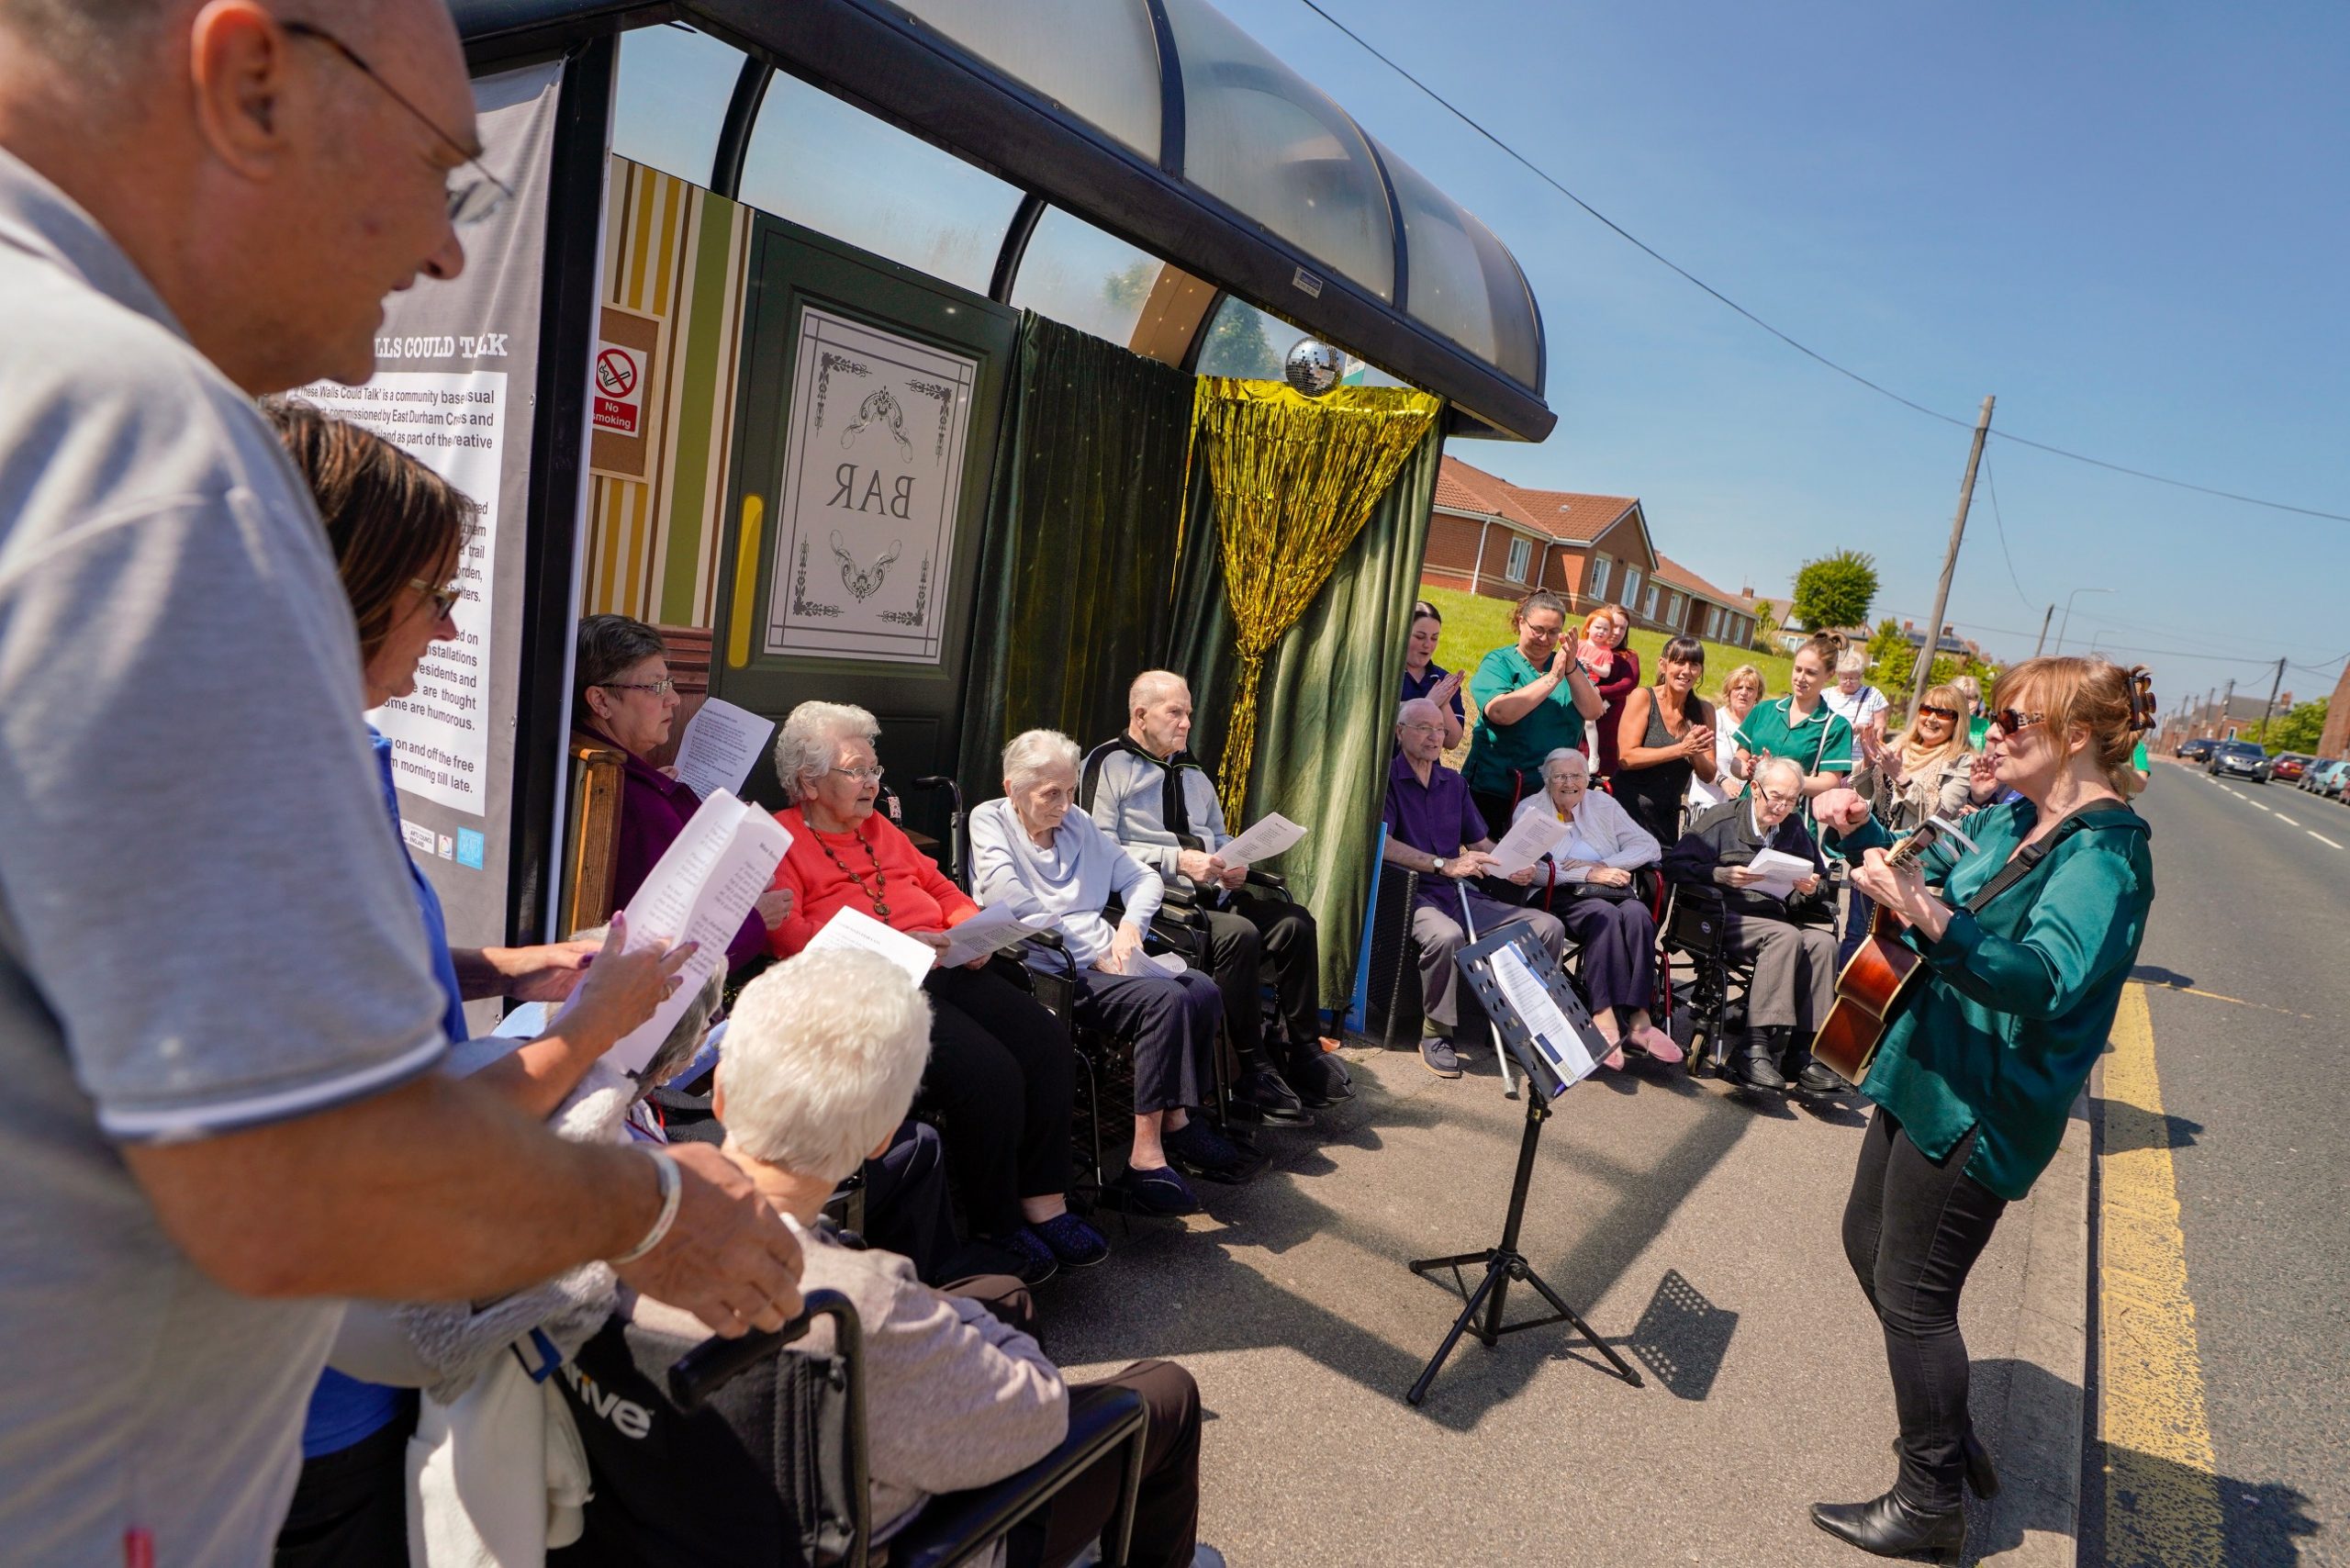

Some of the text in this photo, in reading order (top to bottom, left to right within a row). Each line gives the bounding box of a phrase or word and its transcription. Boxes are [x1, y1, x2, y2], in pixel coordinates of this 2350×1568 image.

[375, 337, 402, 358] LLS
[405, 336, 455, 358] COULD
[319, 386, 340, 398] Walls
[341, 386, 362, 399] Could
[383, 388, 389, 401] is
[390, 392, 394, 401] a
[396, 390, 439, 407] community
[442, 390, 464, 405] base
[605, 401, 620, 413] No
[330, 407, 382, 421] commissioned
[382, 410, 391, 424] by
[392, 409, 408, 422] East
[409, 409, 443, 425] Durham
[469, 412, 494, 426] and
[397, 432, 406, 443] as
[407, 432, 423, 446] part
[425, 432, 436, 445] of
[438, 433, 452, 447] the
[469, 544, 485, 559] trail
[456, 565, 483, 583] orden,
[466, 633, 478, 645] on
[426, 644, 477, 666] nstallations
[416, 663, 476, 689] esidents and
[422, 685, 438, 698] are
[442, 689, 476, 711] thought
[384, 699, 476, 731] ome are humorous.
[395, 738, 408, 752] on
[409, 742, 426, 756] and
[427, 747, 439, 761] off
[439, 751, 452, 767] the
[453, 756, 475, 773] free
[400, 759, 436, 784] morning
[437, 771, 448, 787] till
[451, 775, 473, 794] late.
[565, 1361, 652, 1440] rive
